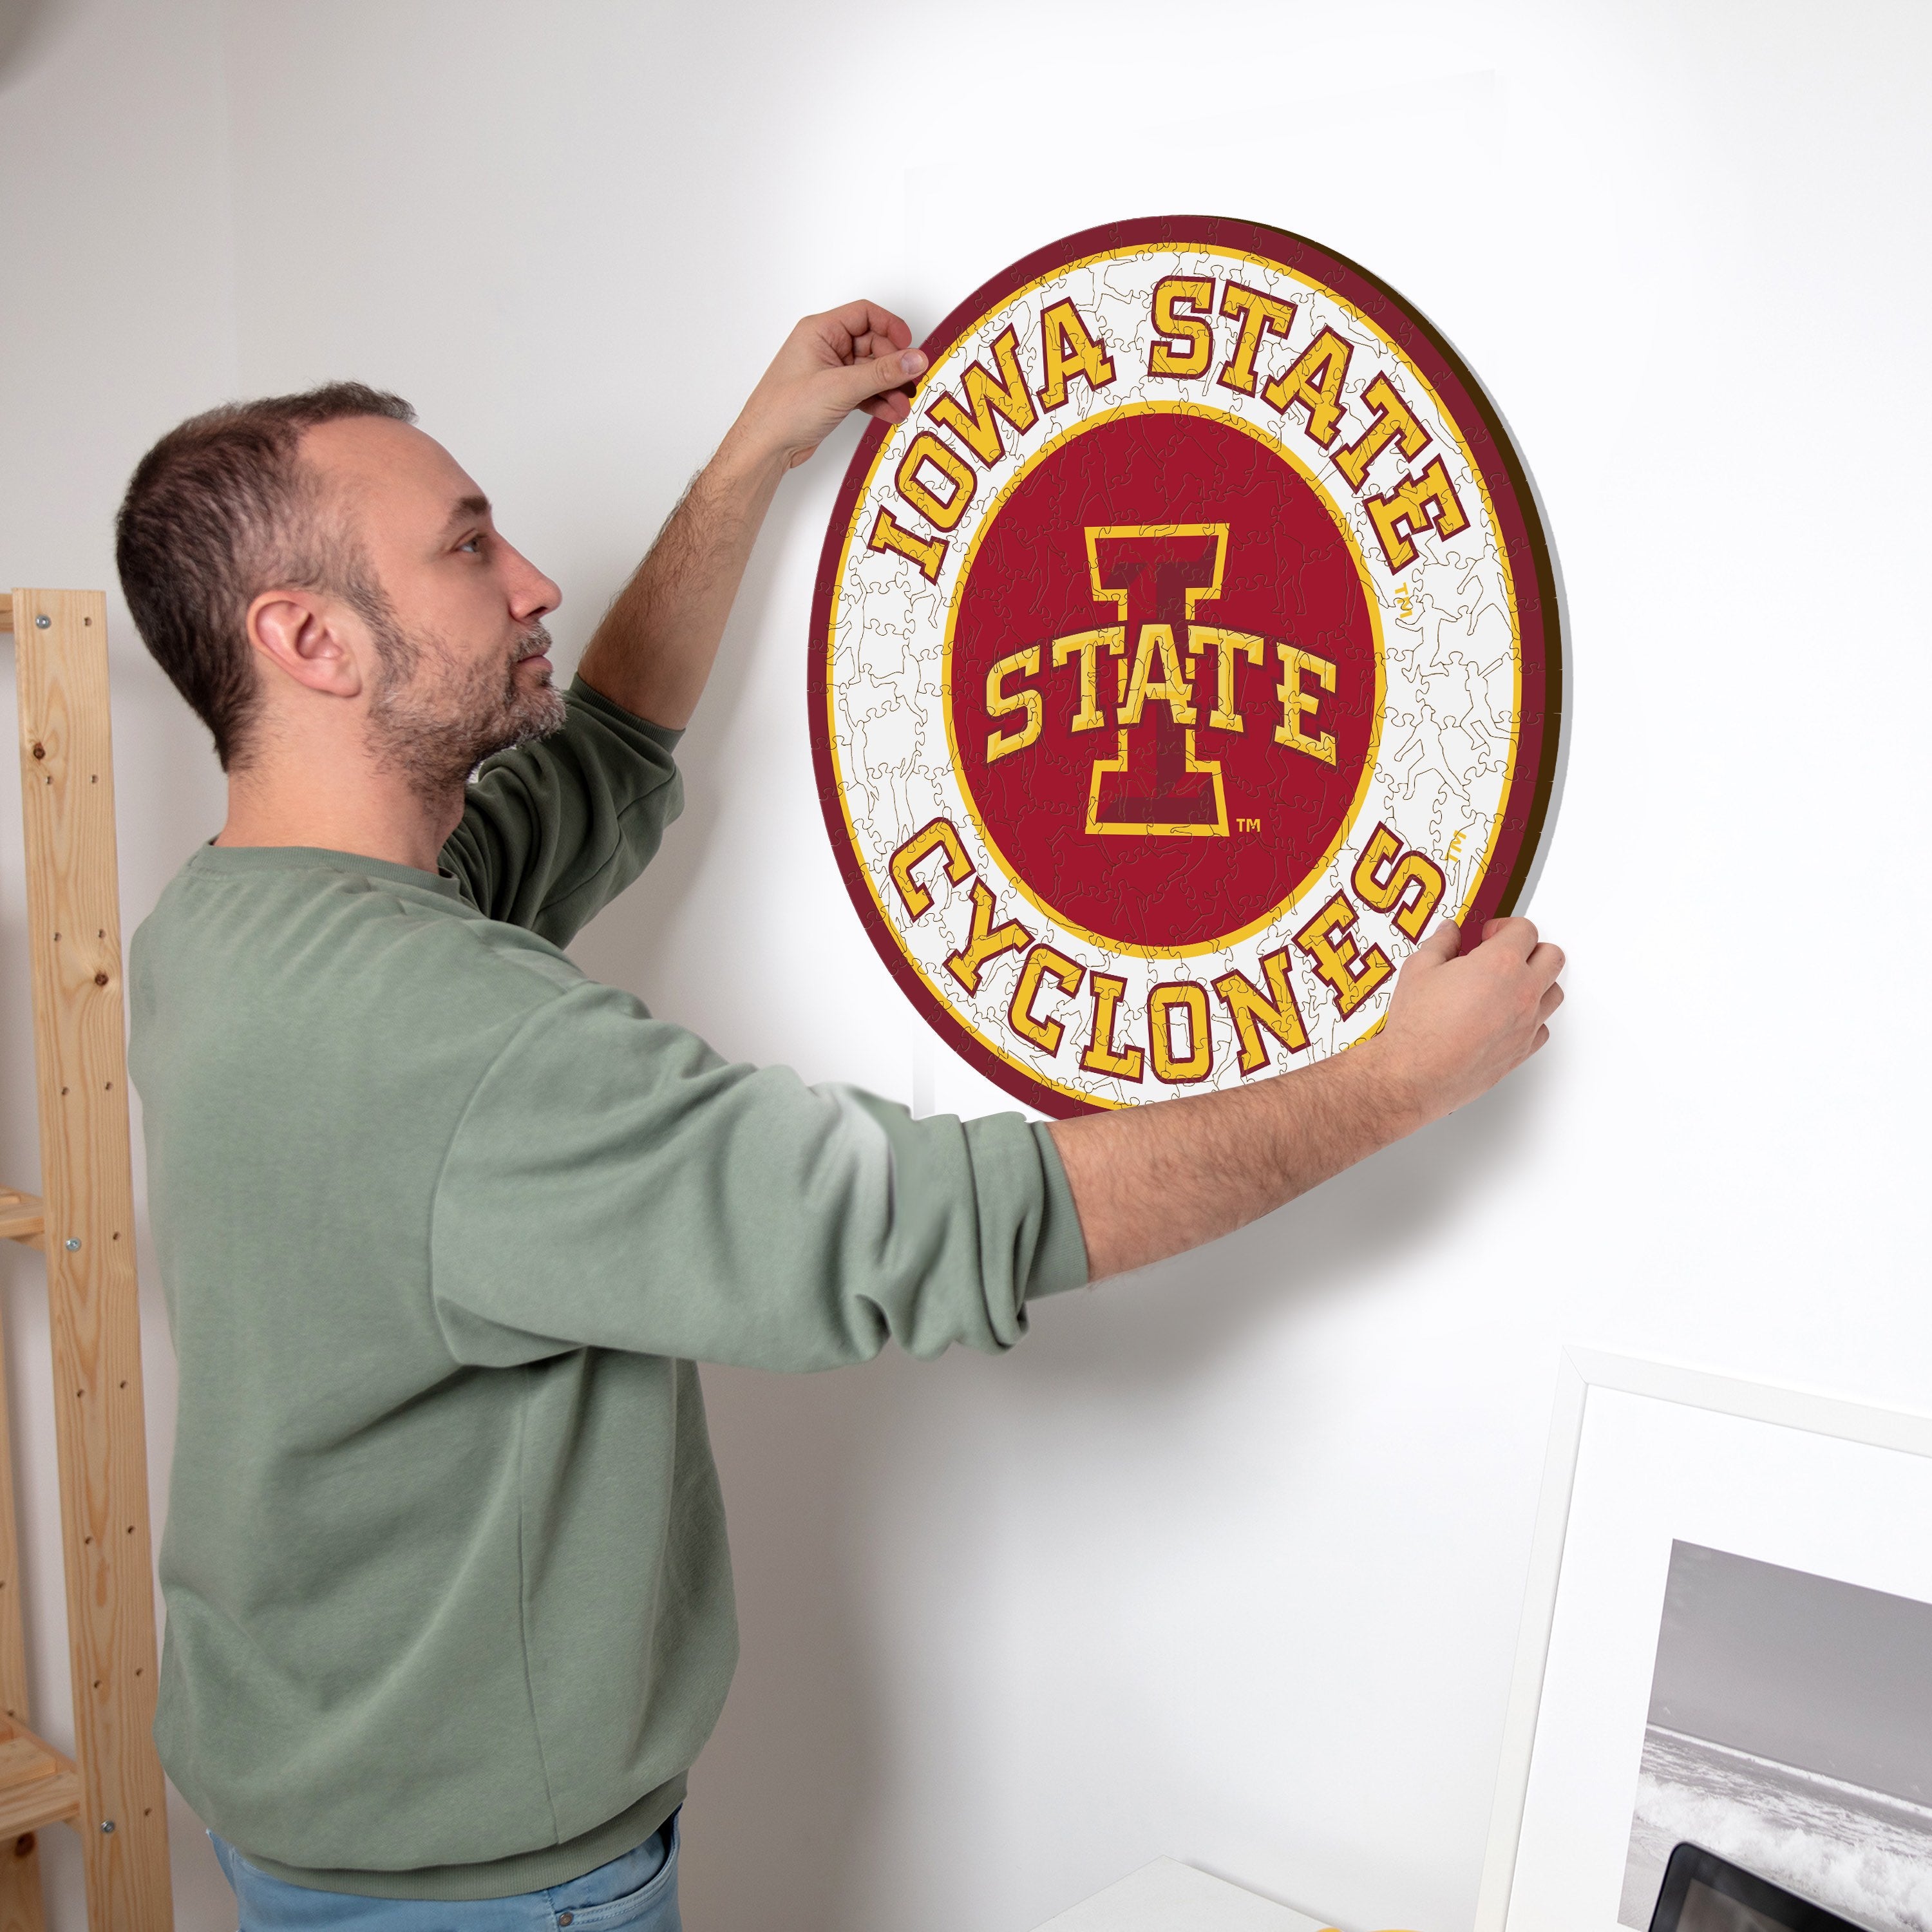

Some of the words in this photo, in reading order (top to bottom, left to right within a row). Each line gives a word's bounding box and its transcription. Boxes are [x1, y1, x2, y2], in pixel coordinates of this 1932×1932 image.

[868, 296, 1116, 585] IOWA
[1147, 275, 1470, 575] STATE
[986, 623, 1337, 767] STATE
[1236, 818, 1260, 833] TM
[888, 816, 1446, 1084] CYCLONES
